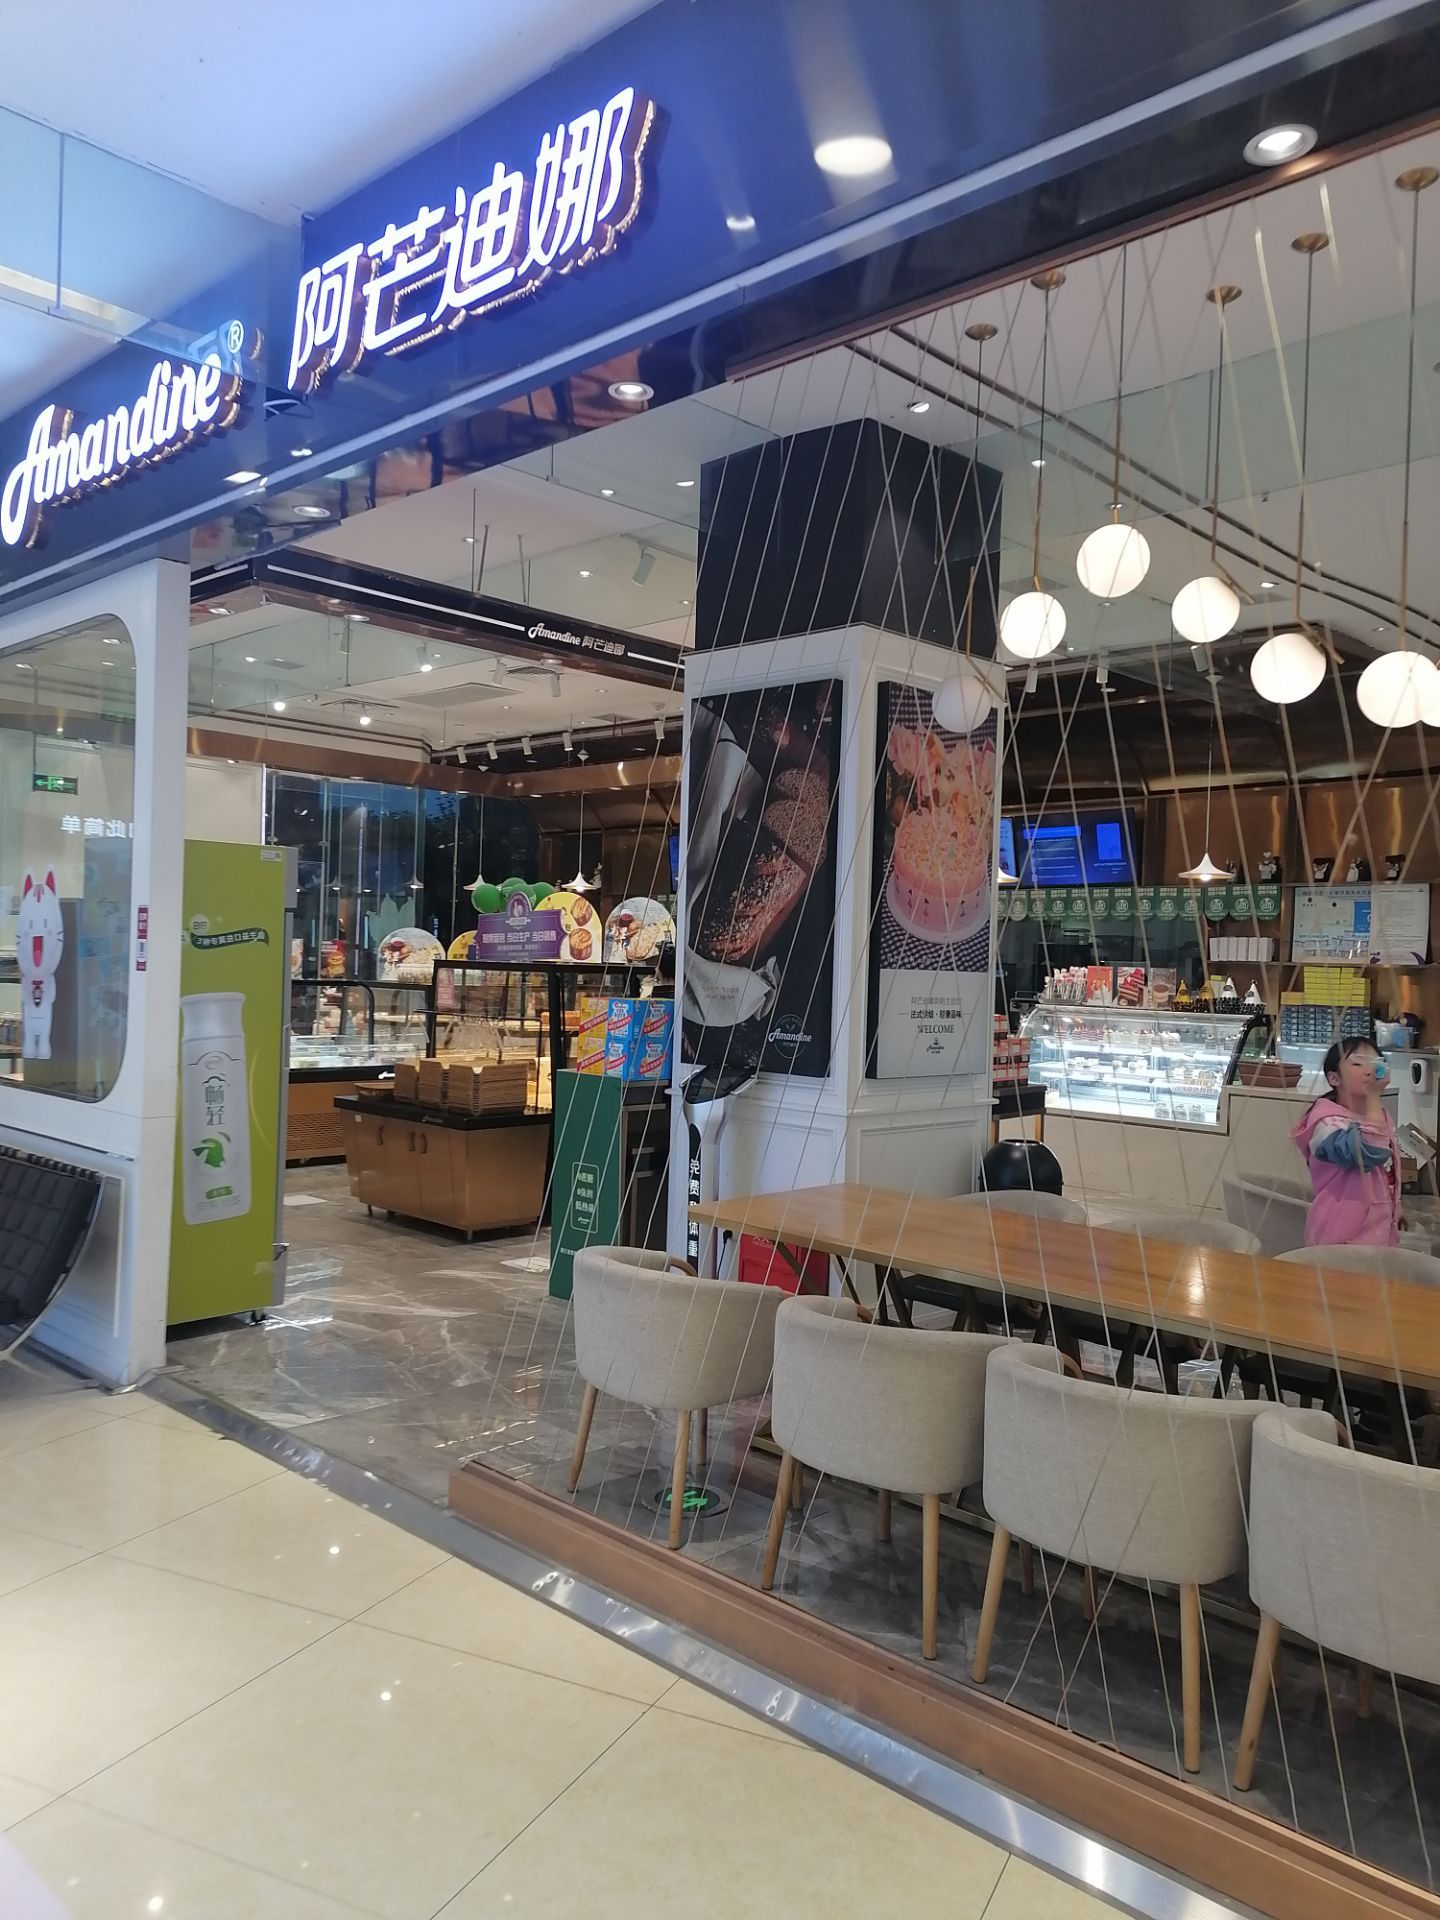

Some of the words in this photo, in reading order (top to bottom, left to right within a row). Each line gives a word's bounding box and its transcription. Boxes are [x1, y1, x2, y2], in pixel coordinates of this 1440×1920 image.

[288, 86, 636, 390] 阿芒迪娜
[1, 352, 221, 546] Amandine
[528, 623, 581, 645] Amandine
[768, 1028, 812, 1043] Amandine
[917, 1024, 955, 1034] WELCOME
[204, 1084, 226, 1127] 畅轻
